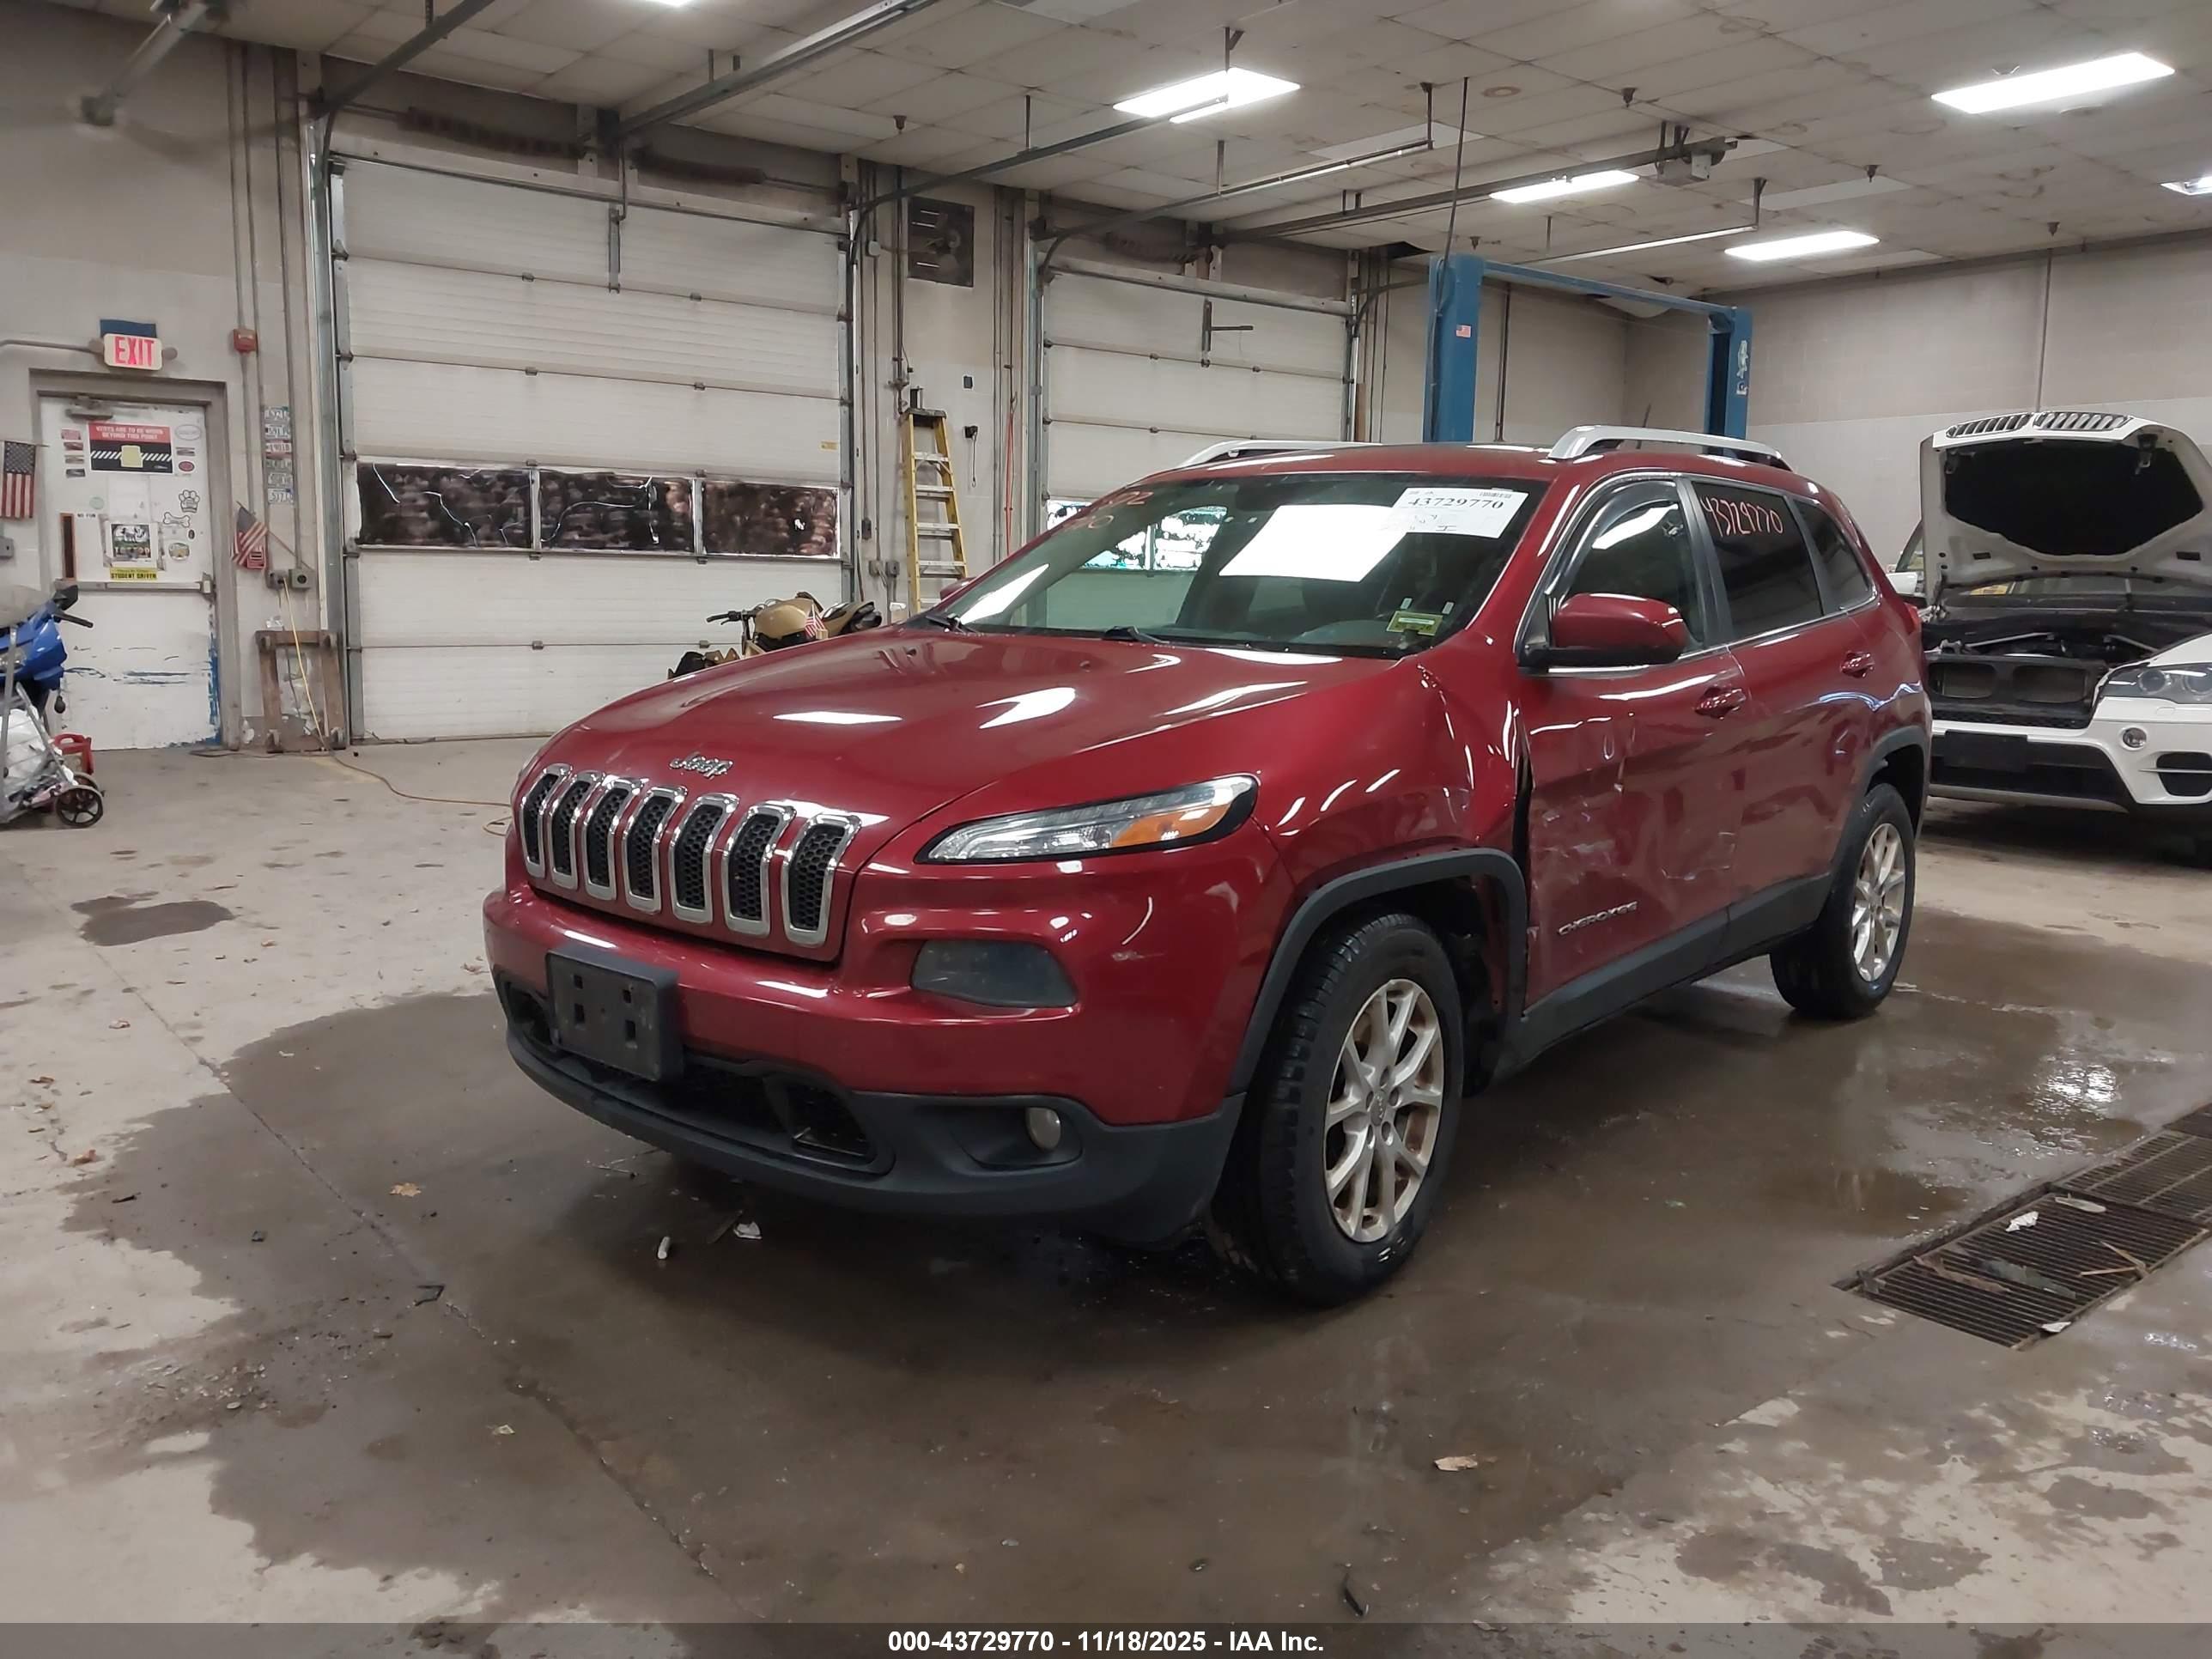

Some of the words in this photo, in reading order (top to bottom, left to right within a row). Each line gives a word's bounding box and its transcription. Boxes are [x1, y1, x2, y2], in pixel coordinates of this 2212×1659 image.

[114, 336, 155, 367] EXIT
[1408, 497, 1504, 509] 43729770
[1700, 496, 1783, 538] 43729770
[669, 750, 734, 781] Jeep
[1559, 902, 1638, 935] CHEROKEE
